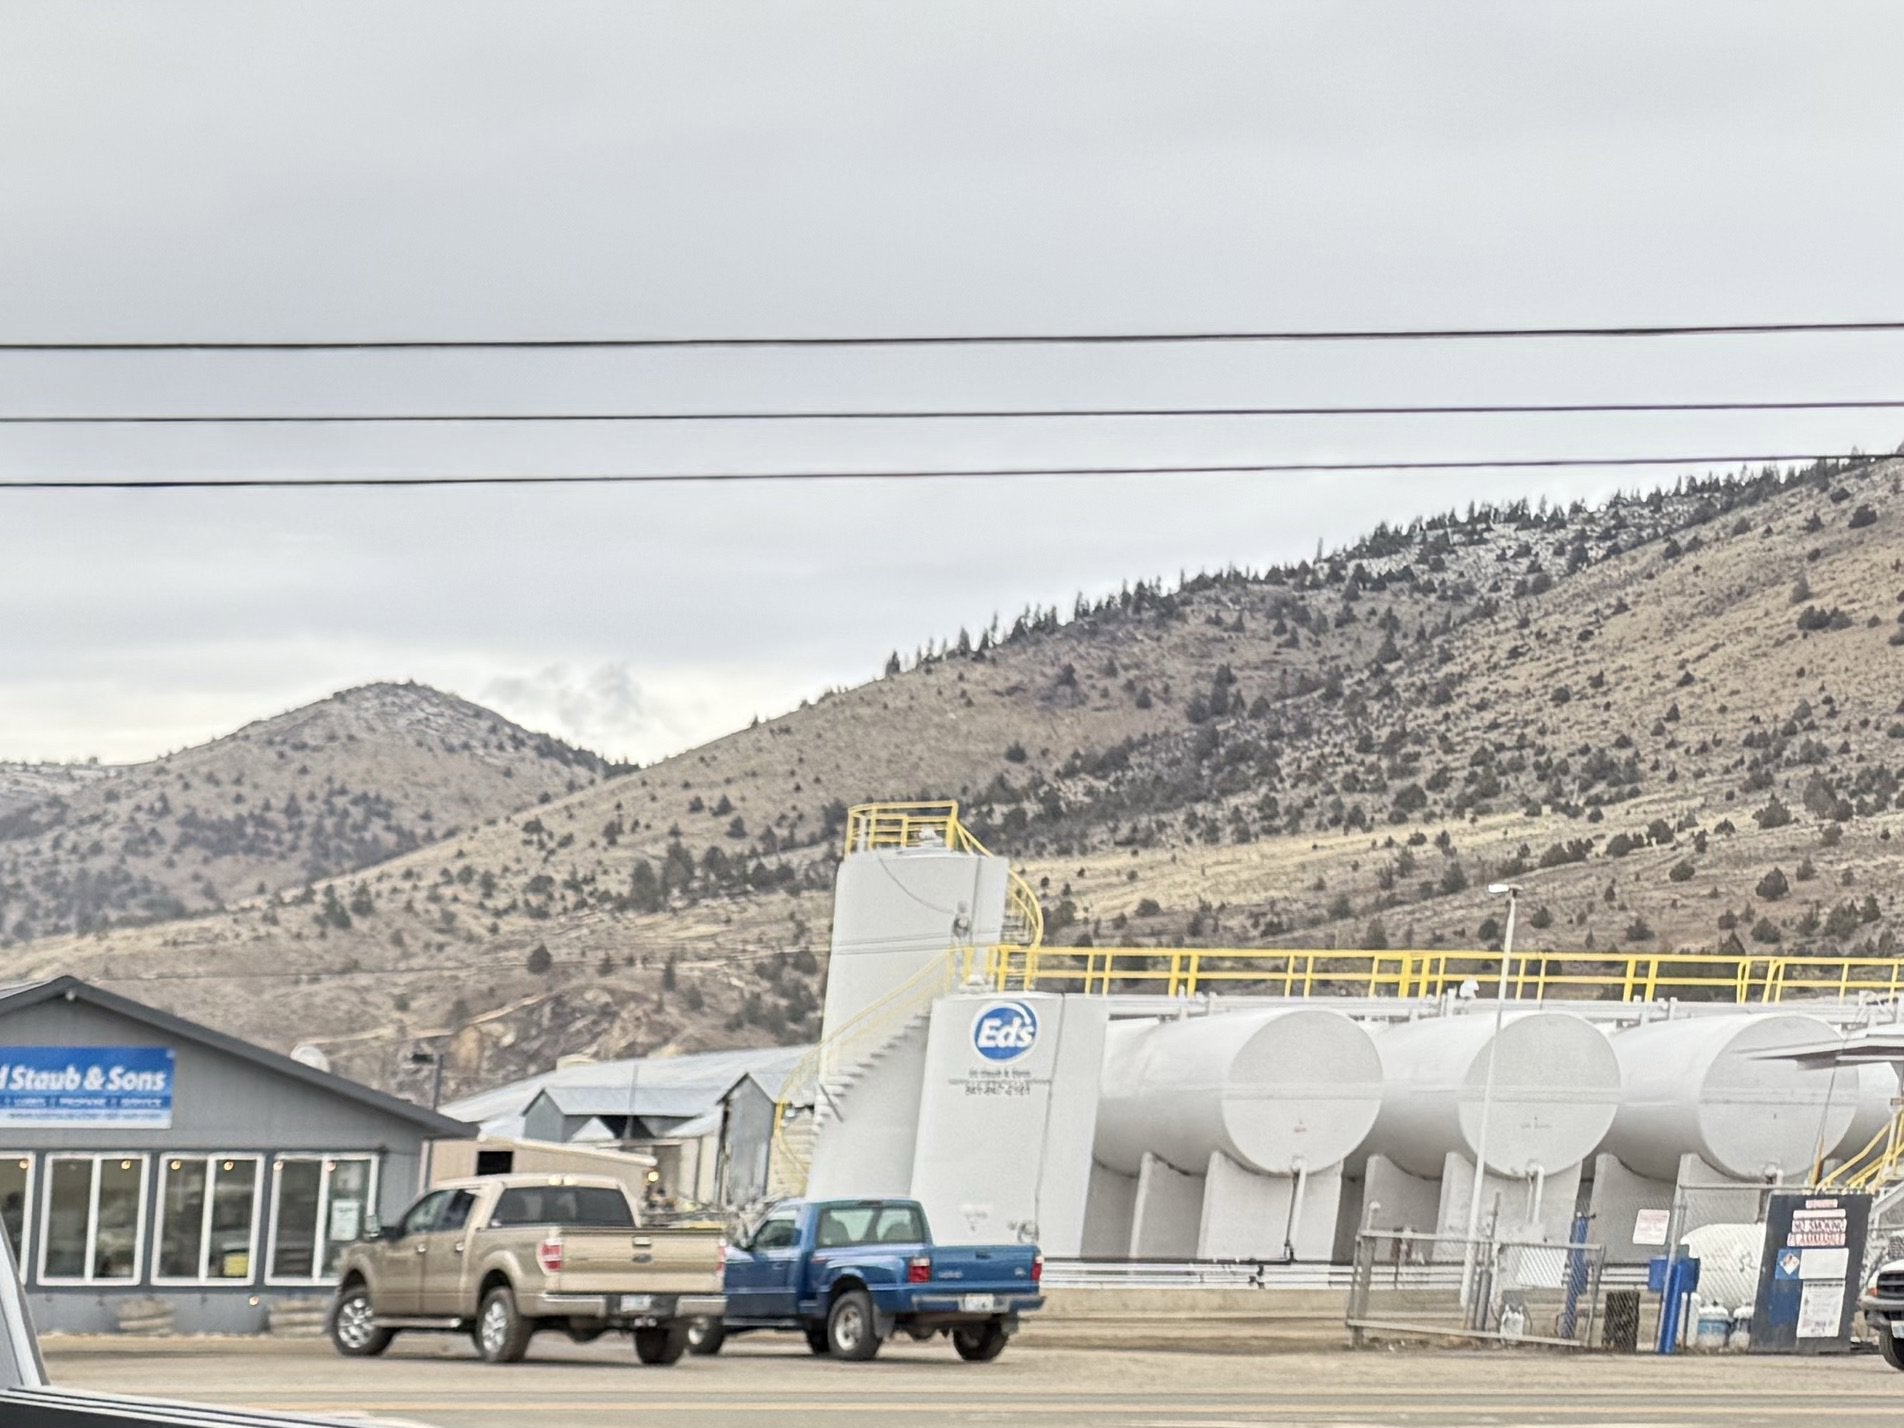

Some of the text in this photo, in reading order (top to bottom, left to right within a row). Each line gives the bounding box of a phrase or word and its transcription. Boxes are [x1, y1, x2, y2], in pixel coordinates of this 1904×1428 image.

[10, 1063, 82, 1091] Staub
[84, 1065, 105, 1091] &
[108, 1066, 166, 1091] Sons
